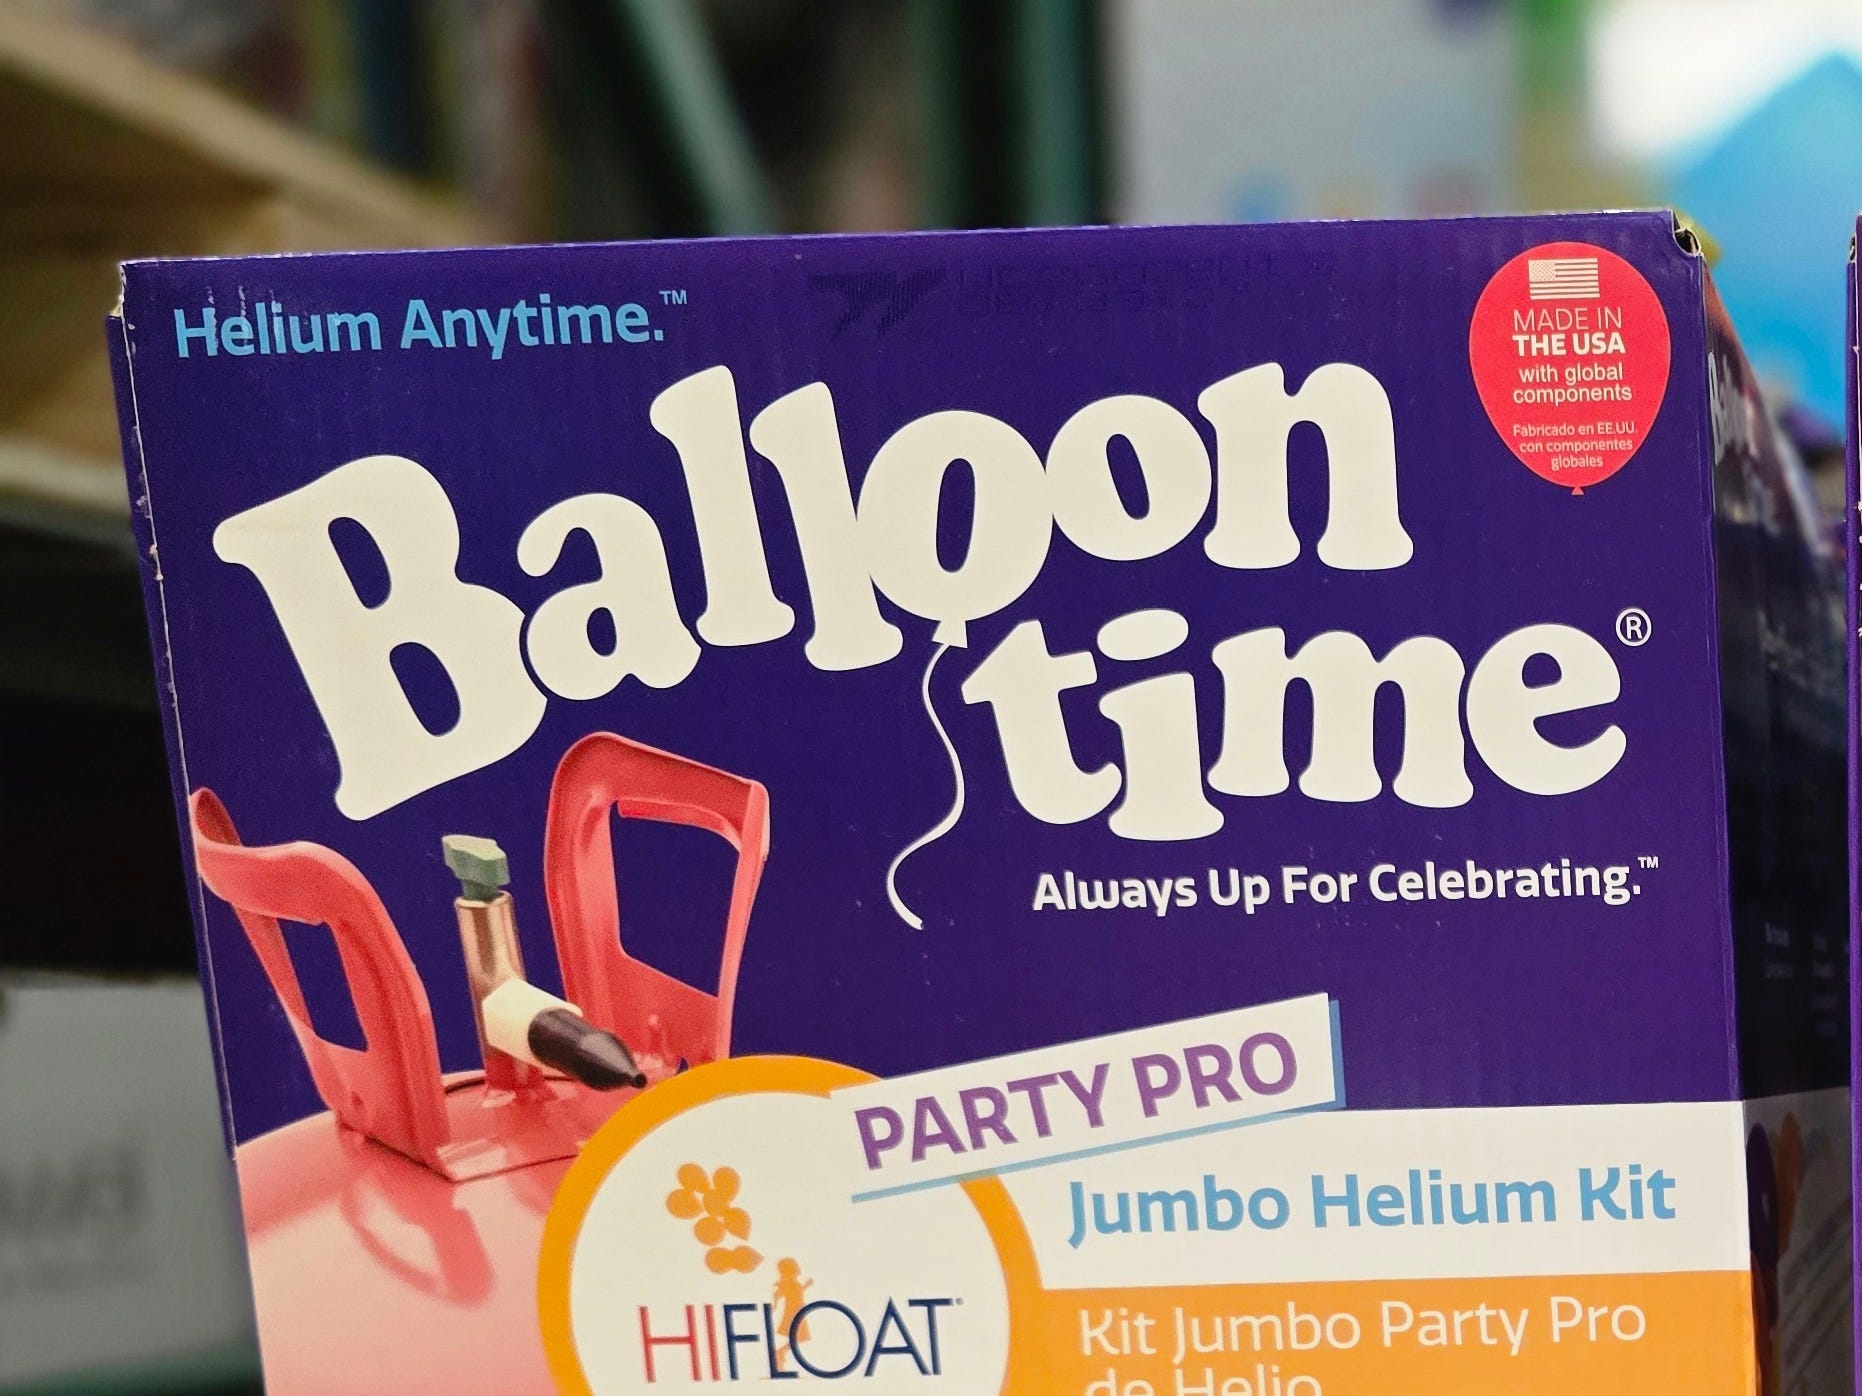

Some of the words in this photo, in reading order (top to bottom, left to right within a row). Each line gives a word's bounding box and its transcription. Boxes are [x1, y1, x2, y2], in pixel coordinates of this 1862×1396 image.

[173, 300, 383, 358] Helium
[1511, 333, 1567, 357] THE
[1572, 331, 1626, 356] USA
[1513, 307, 1589, 332] MADE
[1597, 306, 1622, 330] IN
[1513, 383, 1633, 407] components
[1518, 363, 1559, 384] with
[1564, 361, 1623, 387] global
[213, 362, 1414, 822] Balloon
[1031, 870, 1198, 917] Always
[1208, 867, 1271, 915] Up
[1281, 865, 1358, 904] For
[854, 1063, 1109, 1170] PARTY
[1130, 1031, 1298, 1117] PRO
[1067, 1174, 1290, 1250] Jumbo
[1310, 1168, 1557, 1229] Helium
[1578, 1163, 1676, 1222] Kit
[1079, 1307, 1157, 1357] Kit
[1172, 1300, 1361, 1366] Jumbo
[1380, 1300, 1529, 1357] Party
[1549, 1295, 1646, 1343] Pro
